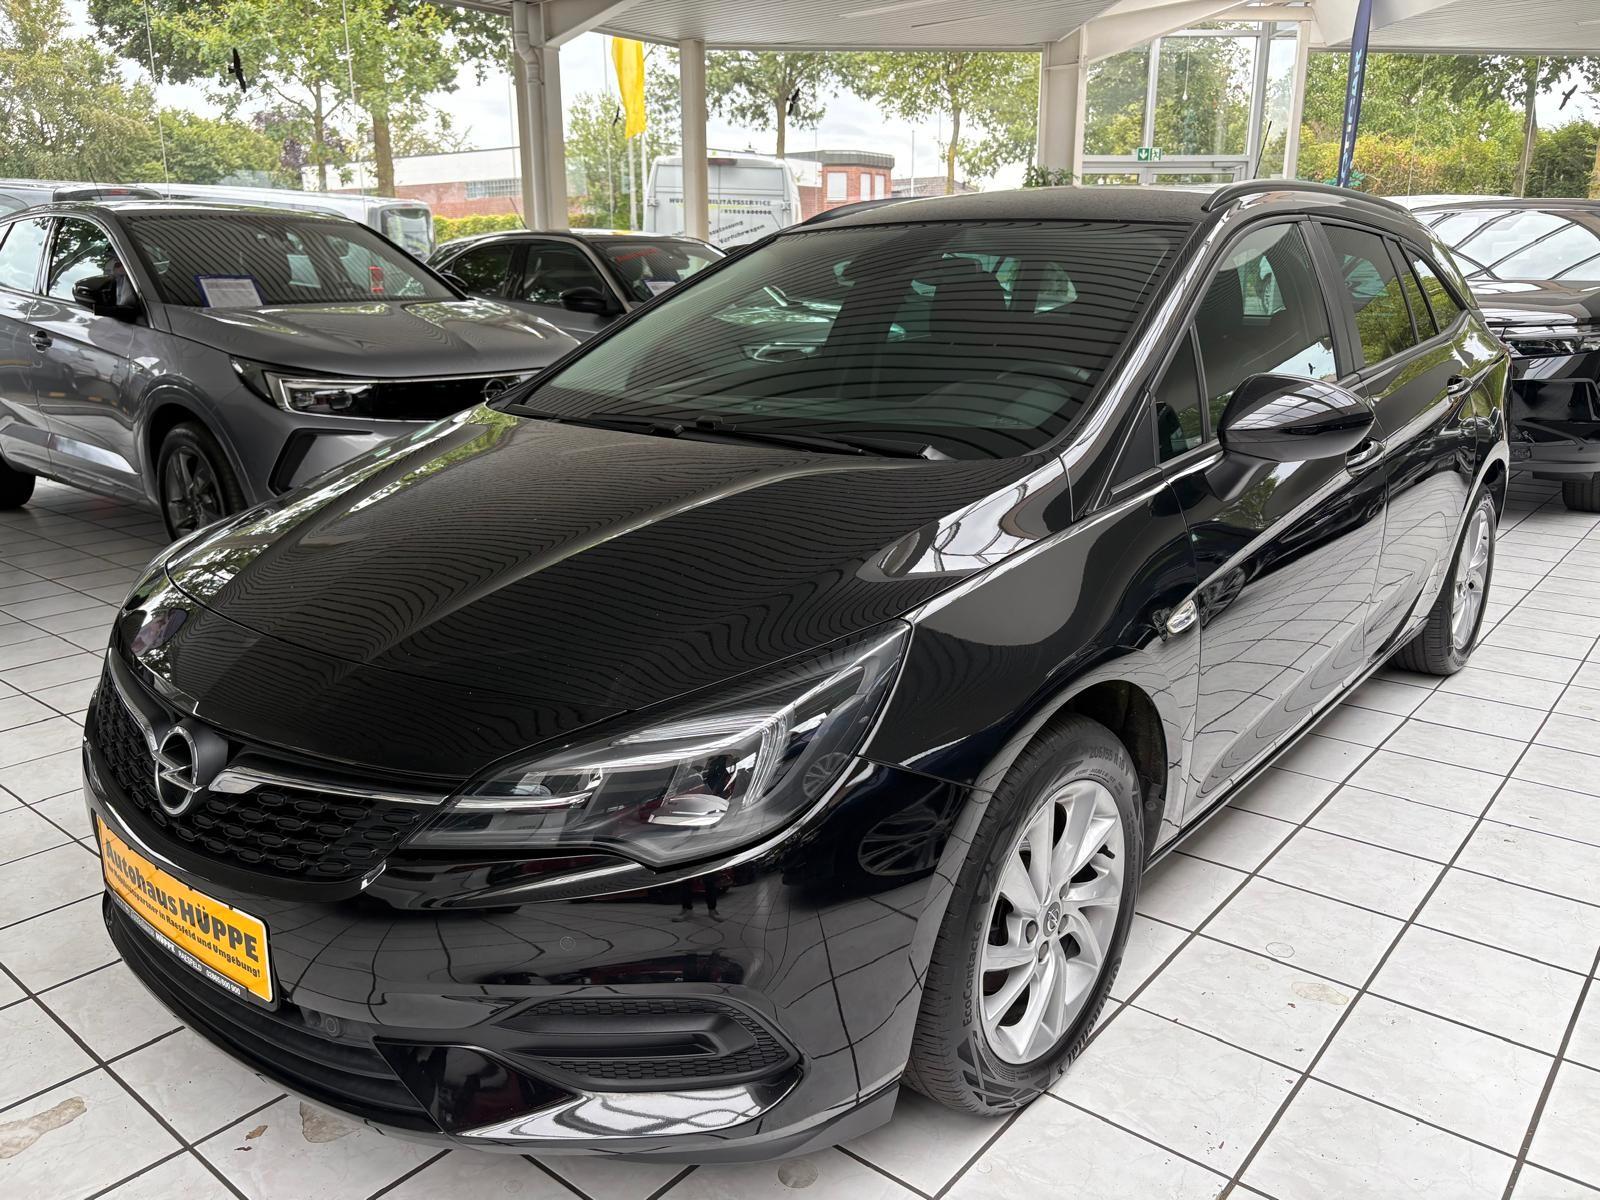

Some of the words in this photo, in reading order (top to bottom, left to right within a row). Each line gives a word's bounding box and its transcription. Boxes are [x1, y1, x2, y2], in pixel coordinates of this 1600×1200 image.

[106, 838, 178, 915] Autohaus
[178, 896, 259, 963] HÜPPE
[165, 915, 196, 941] Raesfeld
[197, 936, 212, 950] und
[212, 943, 261, 978] Umgebung!
[962, 934, 979, 1028] EcoContact
[973, 920, 982, 932] 6
